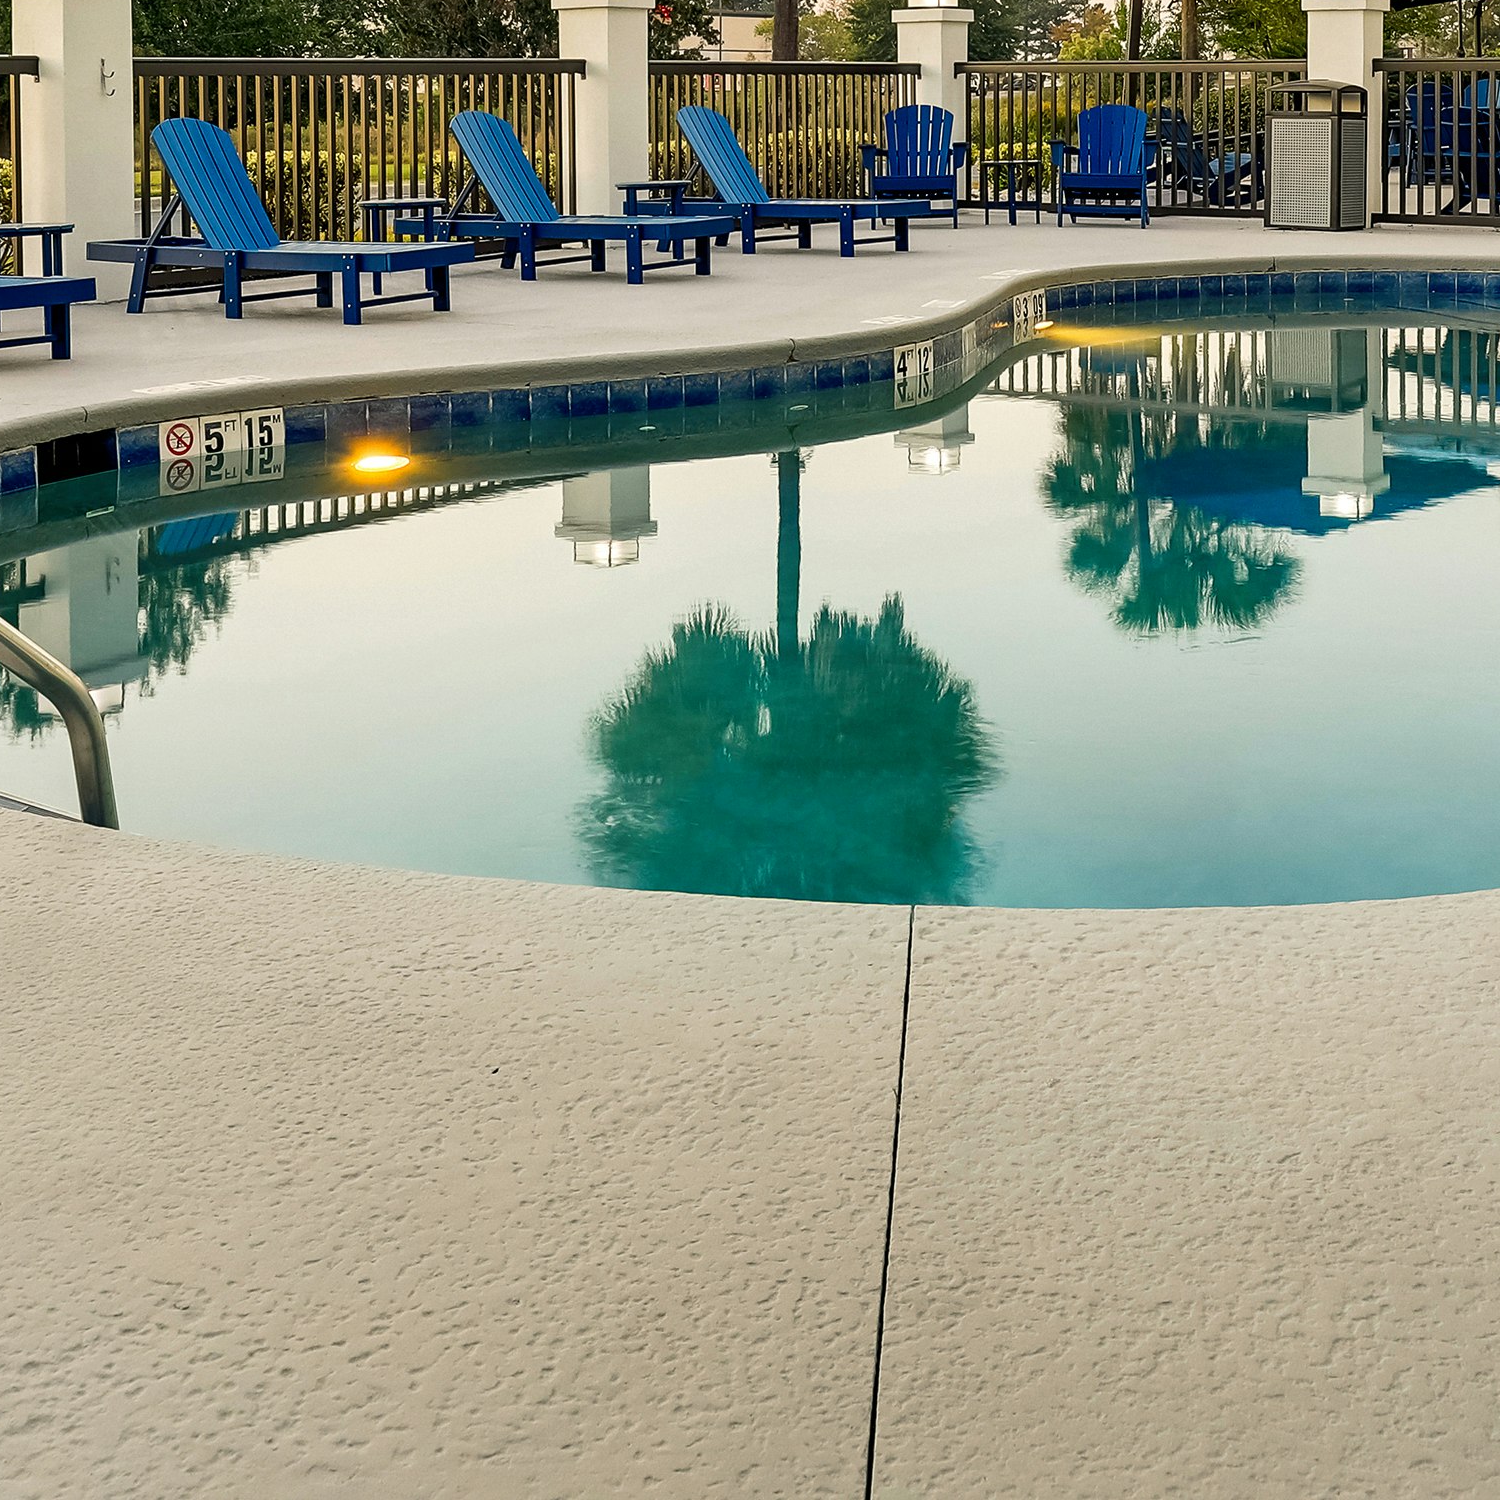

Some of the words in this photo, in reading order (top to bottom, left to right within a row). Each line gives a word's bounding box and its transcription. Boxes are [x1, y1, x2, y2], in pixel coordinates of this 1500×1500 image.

[1022, 297, 1028, 318] 3
[897, 351, 907, 377] 4
[204, 421, 224, 453] 5
[225, 420, 237, 432] FT
[273, 414, 281, 423] M
